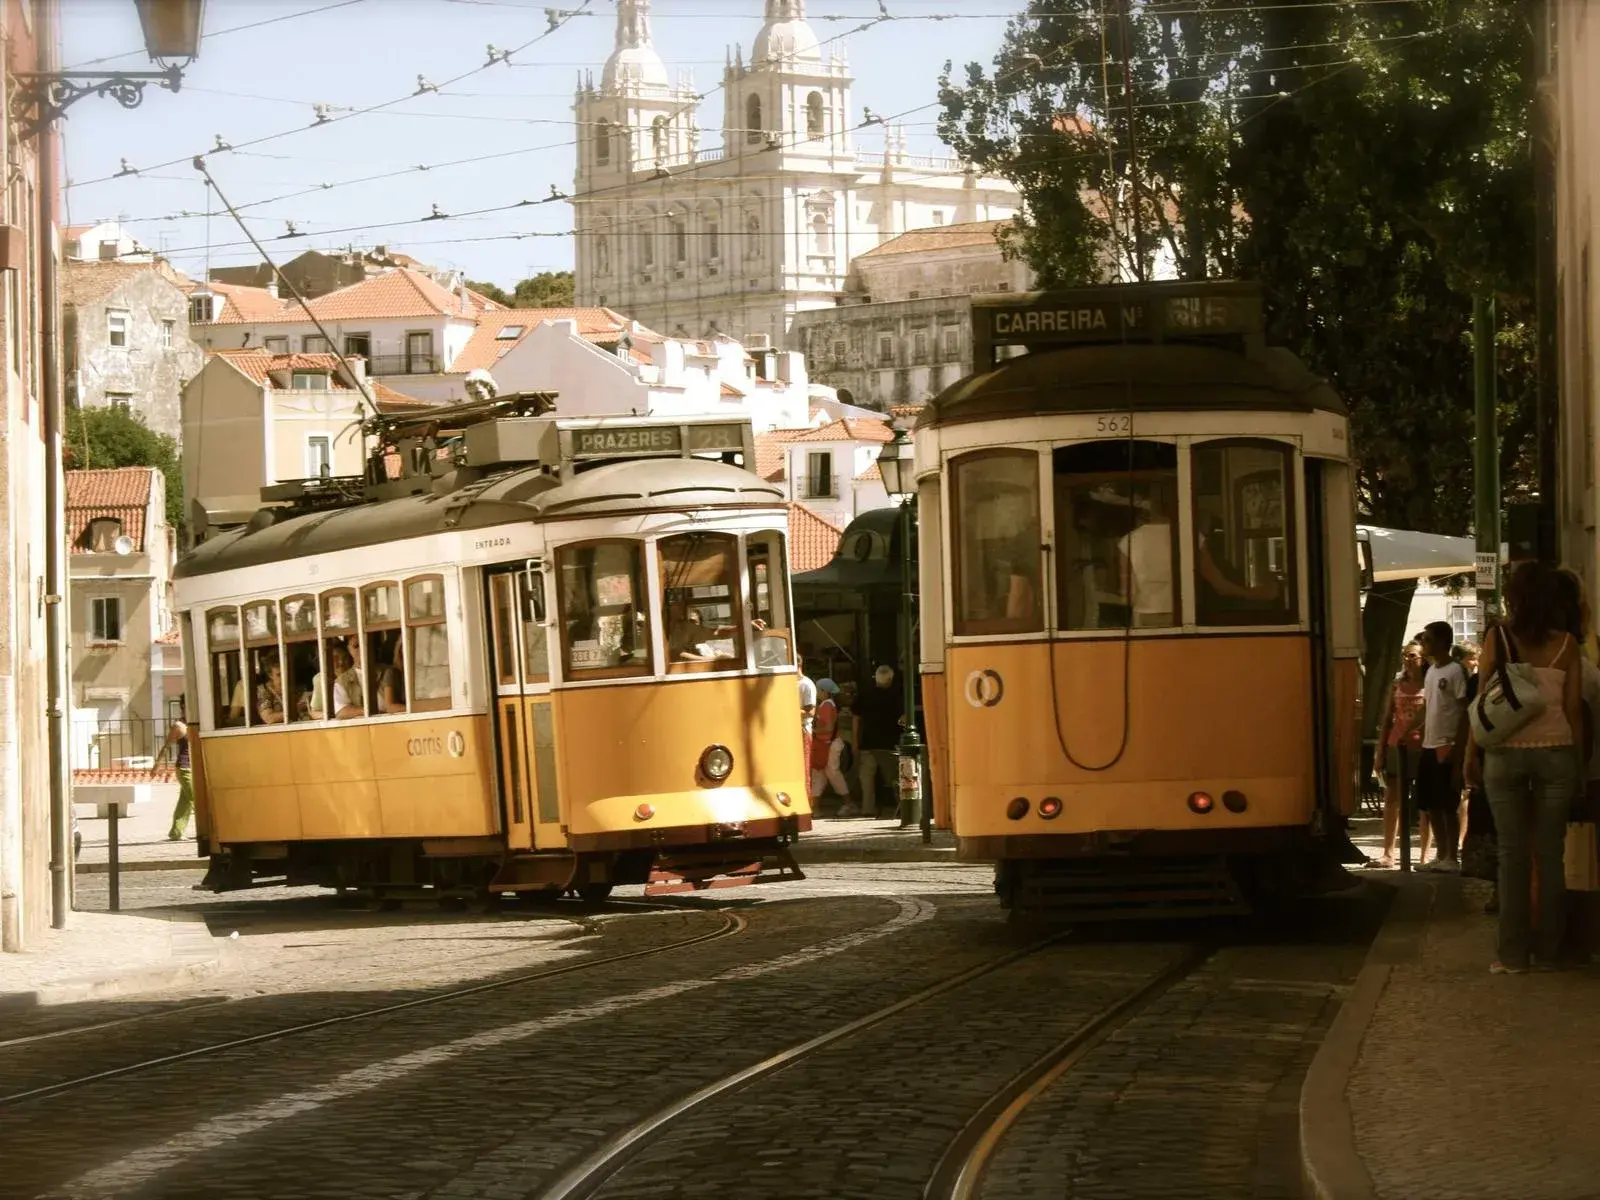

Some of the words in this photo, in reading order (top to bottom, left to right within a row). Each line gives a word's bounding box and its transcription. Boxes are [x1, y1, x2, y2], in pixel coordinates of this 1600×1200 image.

[995, 309, 1107, 333] CARREIRA
[1096, 415, 1130, 431] 562
[581, 430, 673, 450] PRAZERES
[700, 430, 730, 448] 28
[475, 537, 511, 550] ENTRADA
[407, 732, 442, 757] carris
